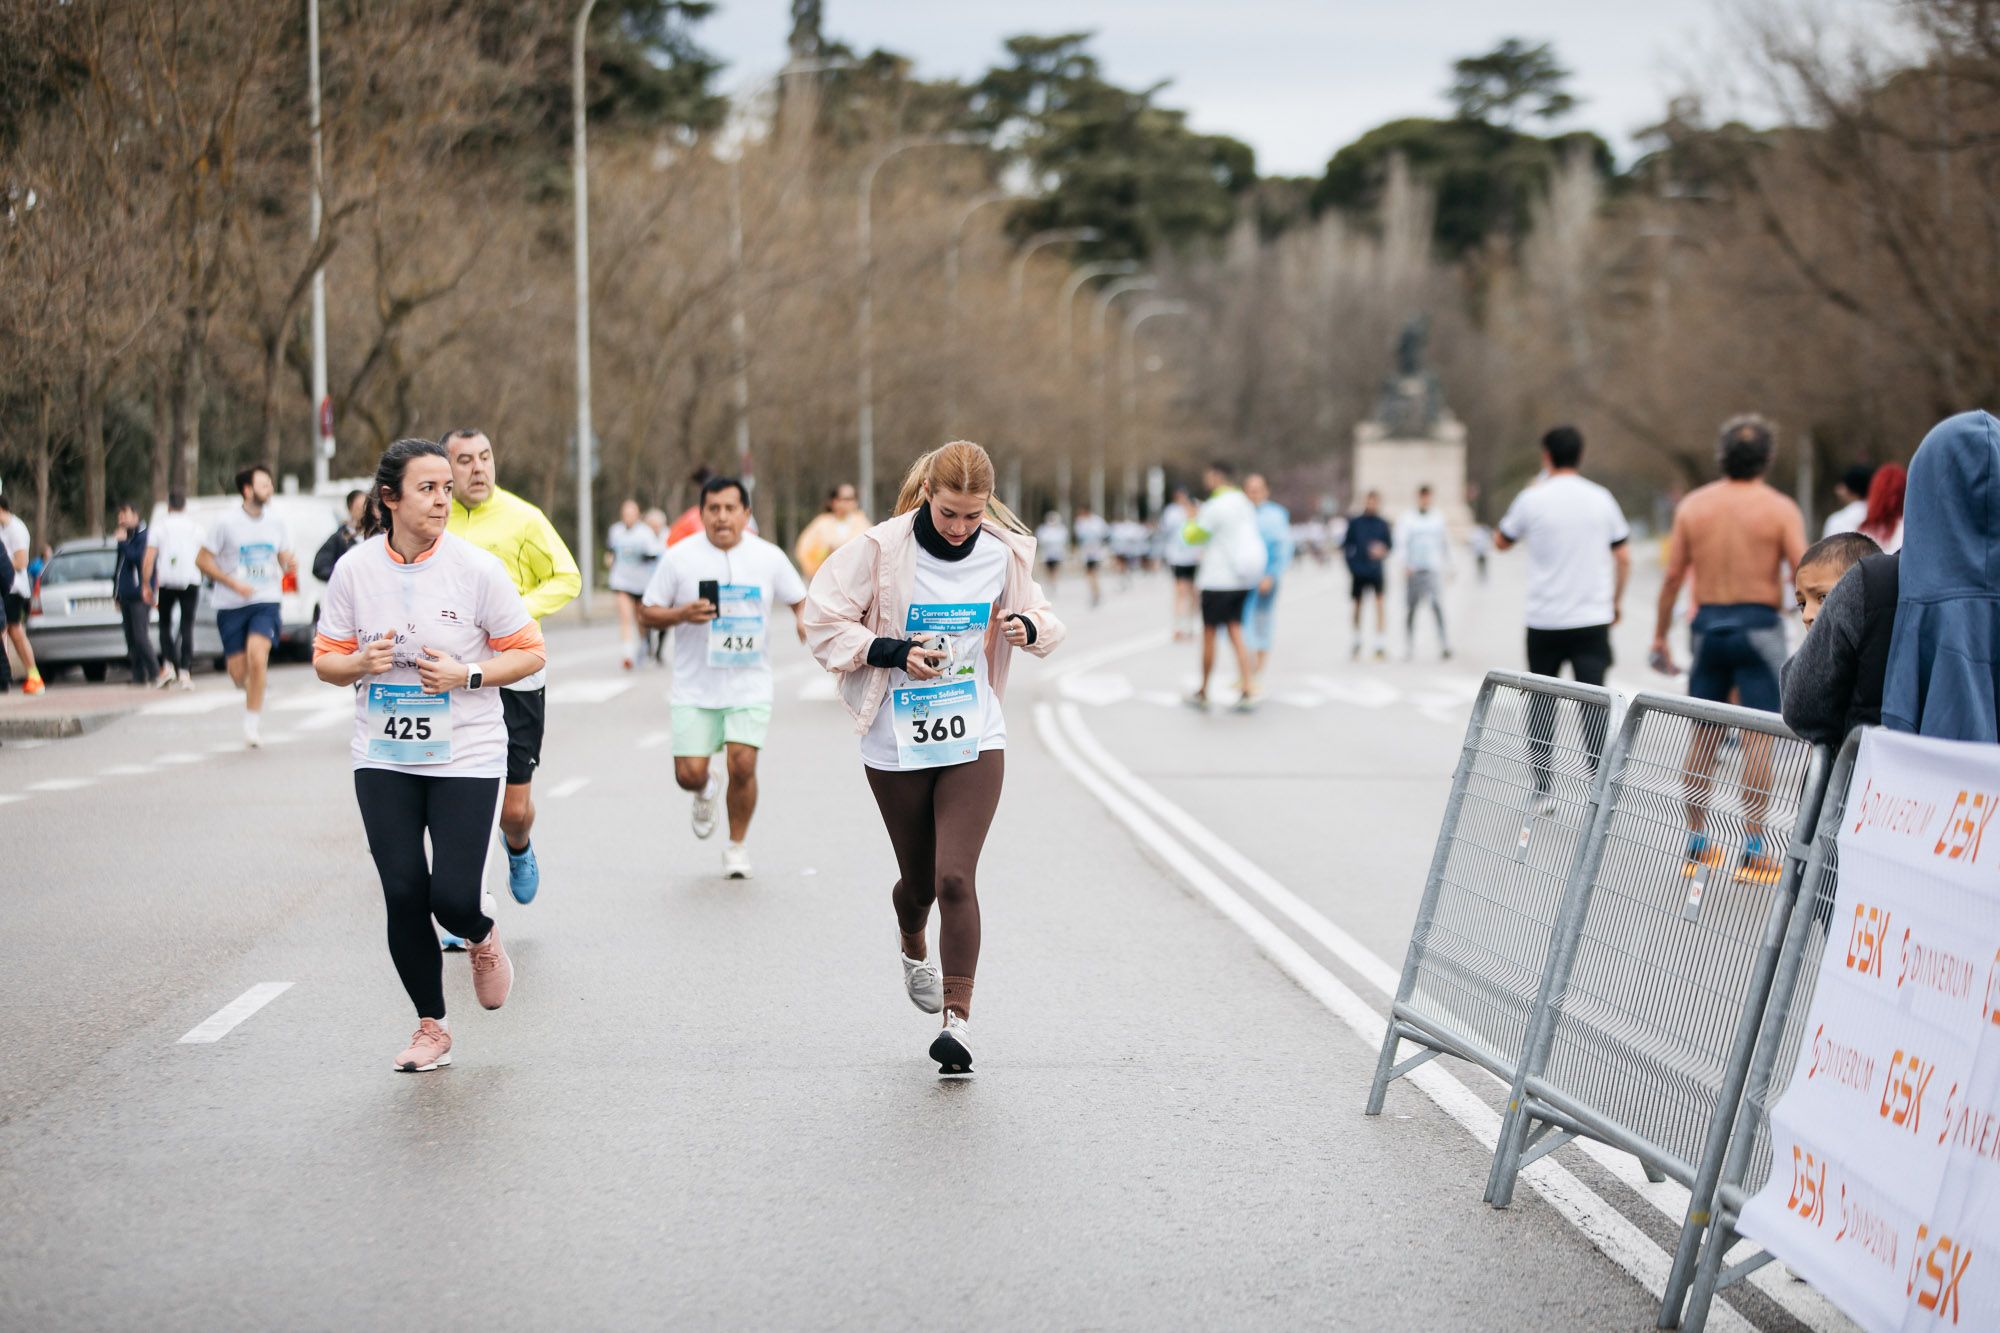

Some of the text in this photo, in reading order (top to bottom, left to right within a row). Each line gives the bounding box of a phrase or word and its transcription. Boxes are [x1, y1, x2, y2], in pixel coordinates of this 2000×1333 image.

[950, 609, 977, 617] Solidaria
[723, 636, 754, 651] 434
[384, 690, 406, 698] Carrera
[938, 688, 965, 699] Solidaria
[384, 716, 432, 741] 425
[912, 715, 966, 744] 360
[1934, 790, 1999, 865] GSK
[1846, 903, 1891, 979] GSK
[1910, 944, 1973, 1001] DIAVERUM
[1880, 1048, 1935, 1134] GSK
[1787, 1144, 1826, 1228] GSK
[1906, 1223, 1973, 1326] GSK
